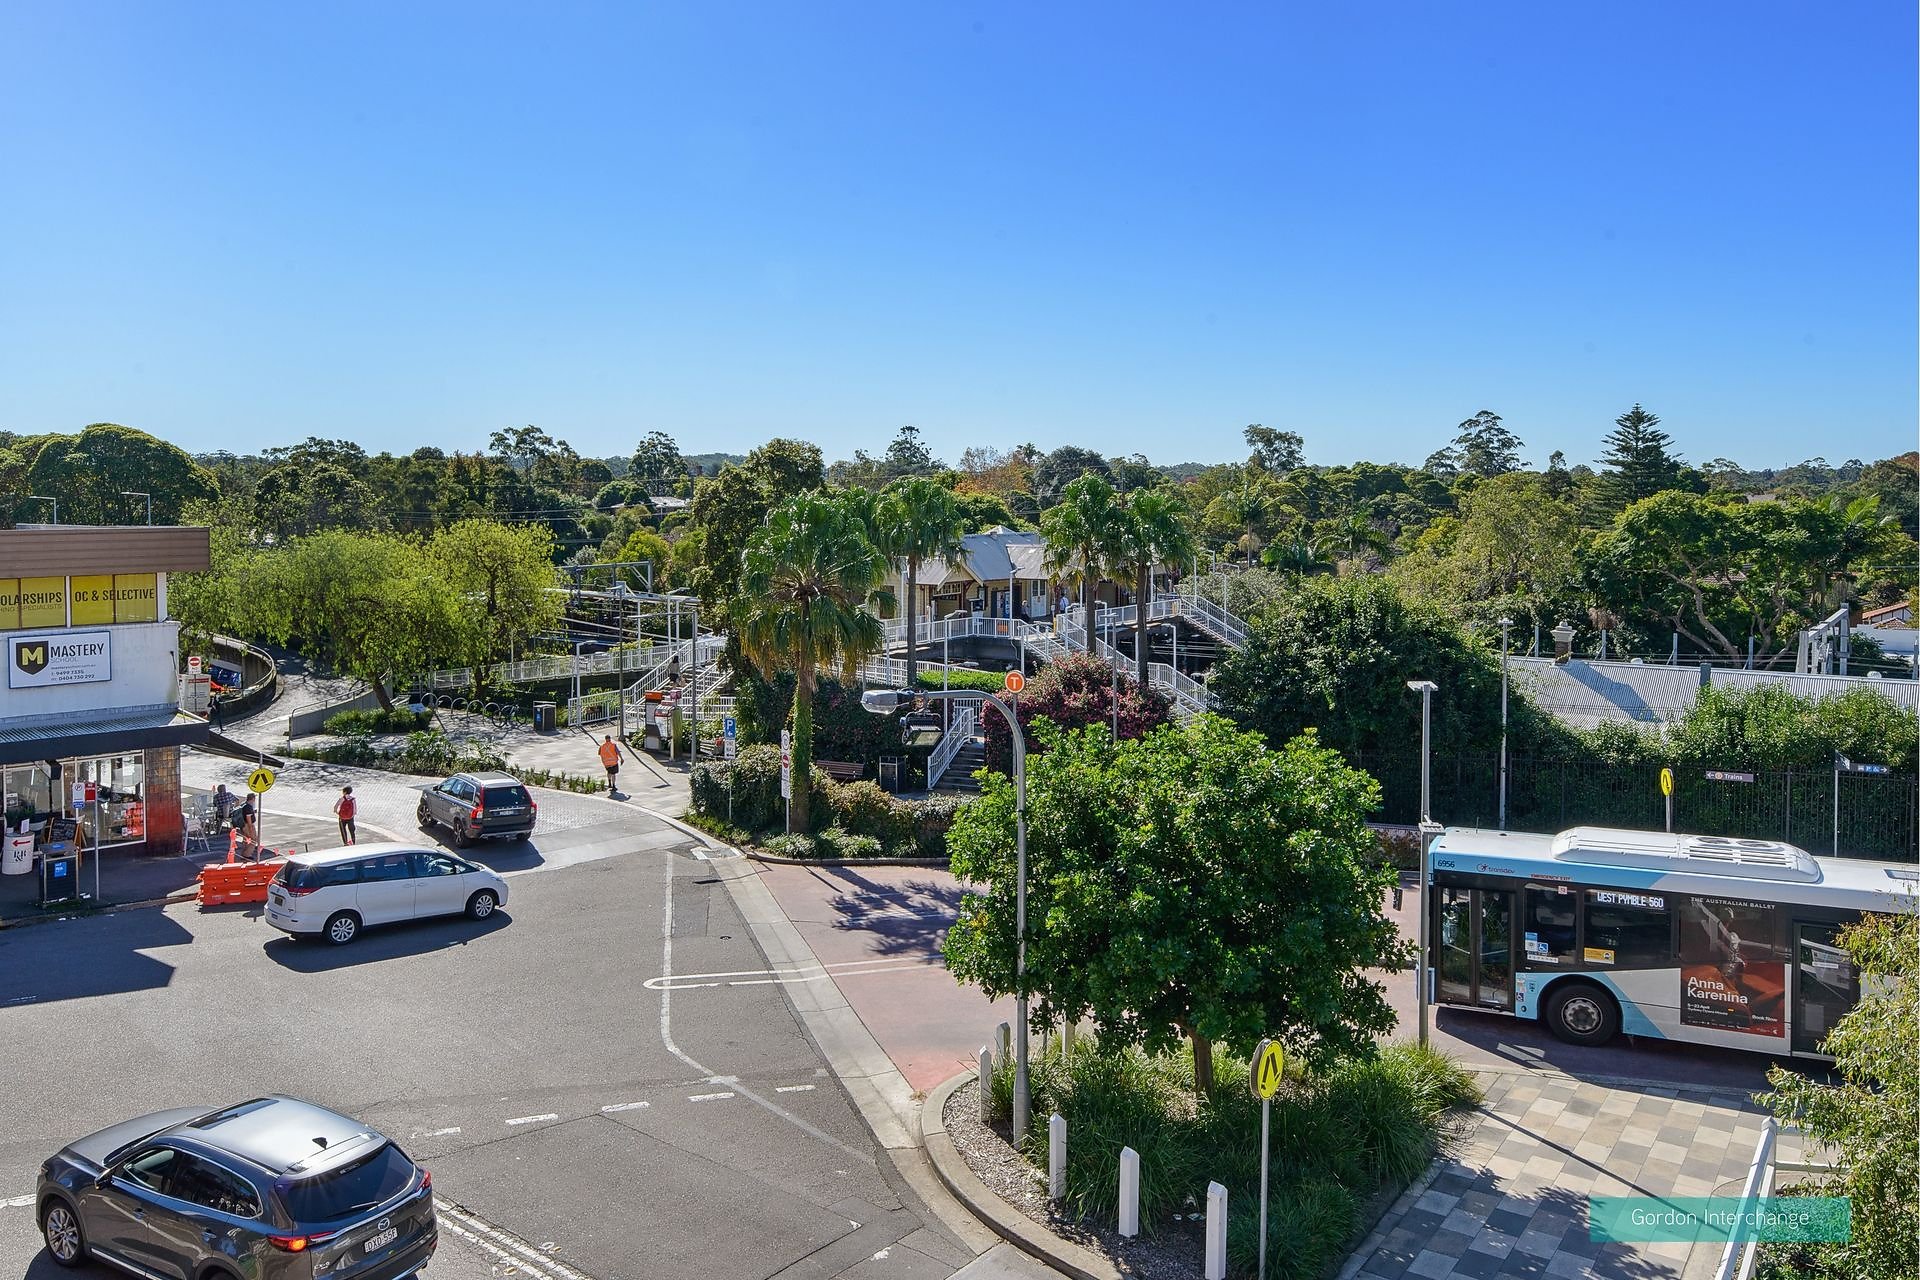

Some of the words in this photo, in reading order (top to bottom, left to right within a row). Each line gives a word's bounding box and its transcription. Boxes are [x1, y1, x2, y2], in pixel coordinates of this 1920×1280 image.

[74, 590, 88, 602] OC
[91, 590, 99, 601] &
[102, 588, 155, 601] SELECTIVE
[21, 646, 44, 666] M
[50, 643, 104, 658] MASTERY
[726, 720, 734, 729] P
[1437, 859, 1455, 868] 6956
[1597, 891, 1617, 904] WEST
[1618, 893, 1647, 907] PYMBLE
[1648, 896, 1664, 908] 560
[1705, 898, 1748, 907] AUSTRALIAN
[1749, 901, 1776, 910] BALLET
[1687, 976, 1724, 991] Anna
[1687, 986, 1748, 1004] Karenina
